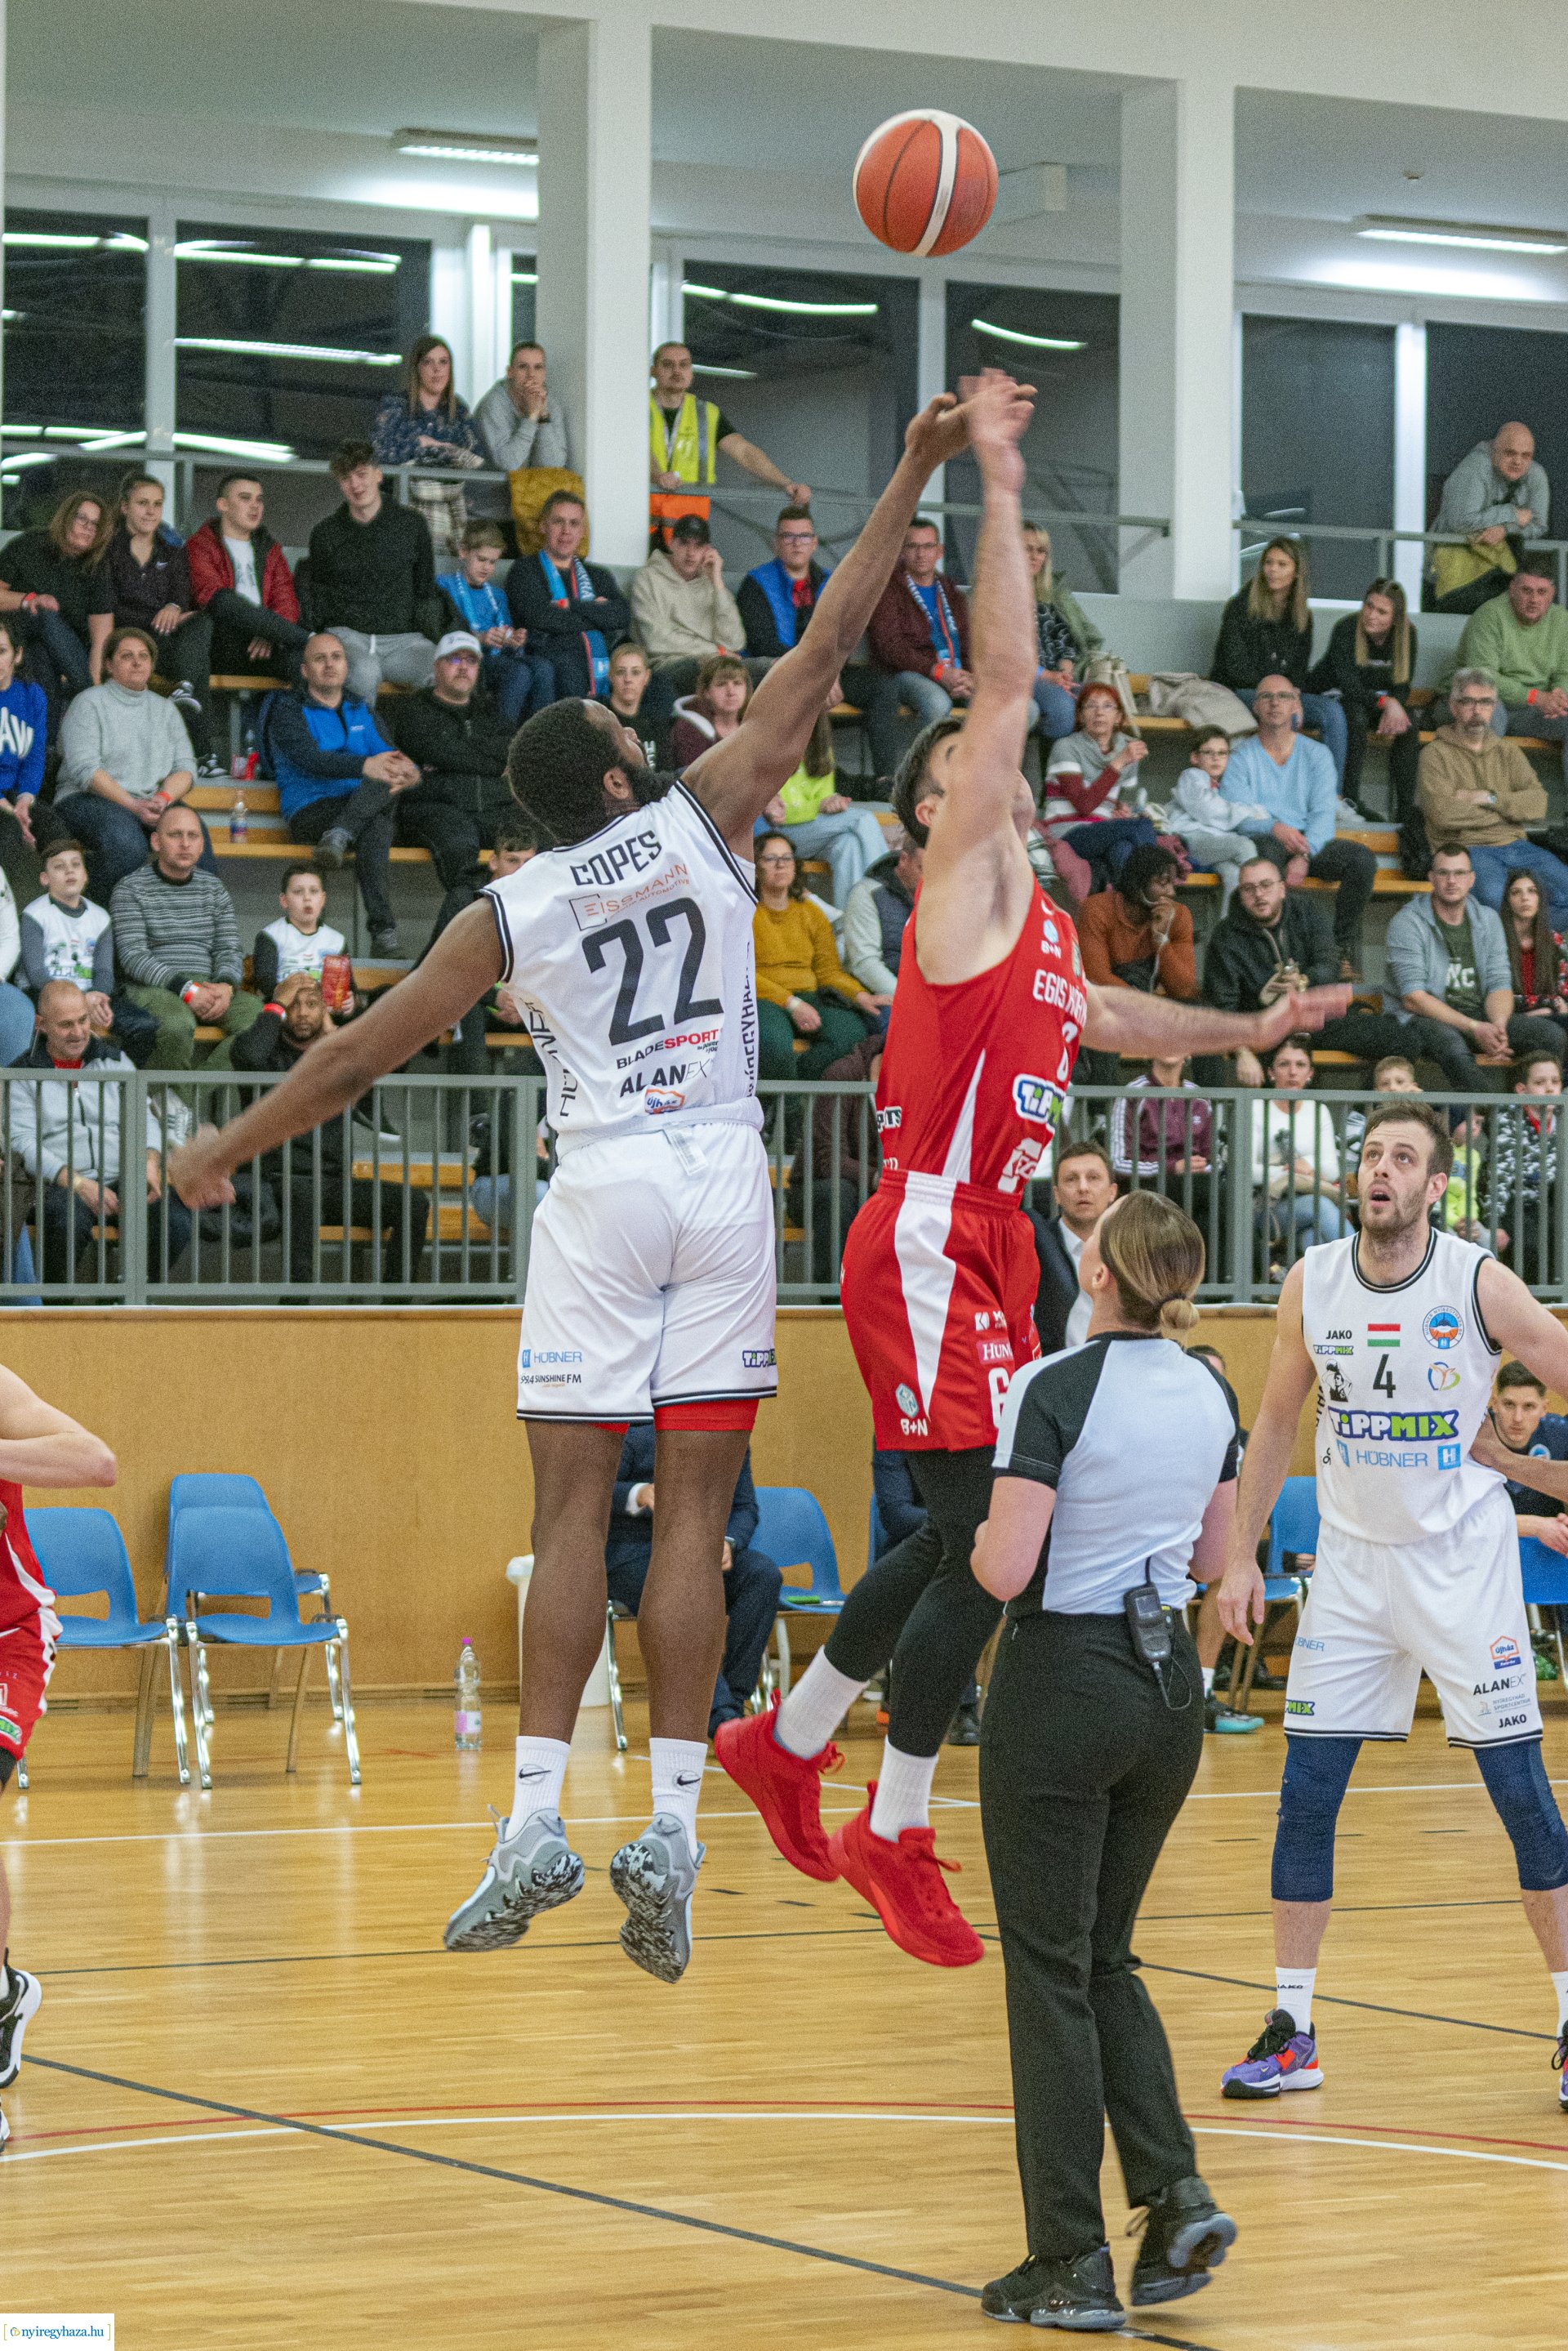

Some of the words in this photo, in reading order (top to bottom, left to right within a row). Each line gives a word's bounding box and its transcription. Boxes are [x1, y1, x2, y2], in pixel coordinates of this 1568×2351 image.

[569, 830, 662, 886] COPES
[577, 863, 688, 917] EISSMANN
[581, 897, 724, 1046] 22
[1032, 969, 1067, 1009] EGIS
[616, 1028, 719, 1069] BLADESPORT
[620, 1059, 710, 1098] ALANEX
[1325, 1330, 1352, 1340] JAKO
[535, 1374, 565, 1383] SUNSHINE
[567, 1374, 581, 1384] FM
[1373, 1354, 1396, 1399] 4
[900, 1418, 929, 1436] B+N
[1356, 1449, 1428, 1467] HÜBNER
[1473, 1675, 1526, 1695] ALANEX
[1499, 1714, 1527, 1729] JAKO
